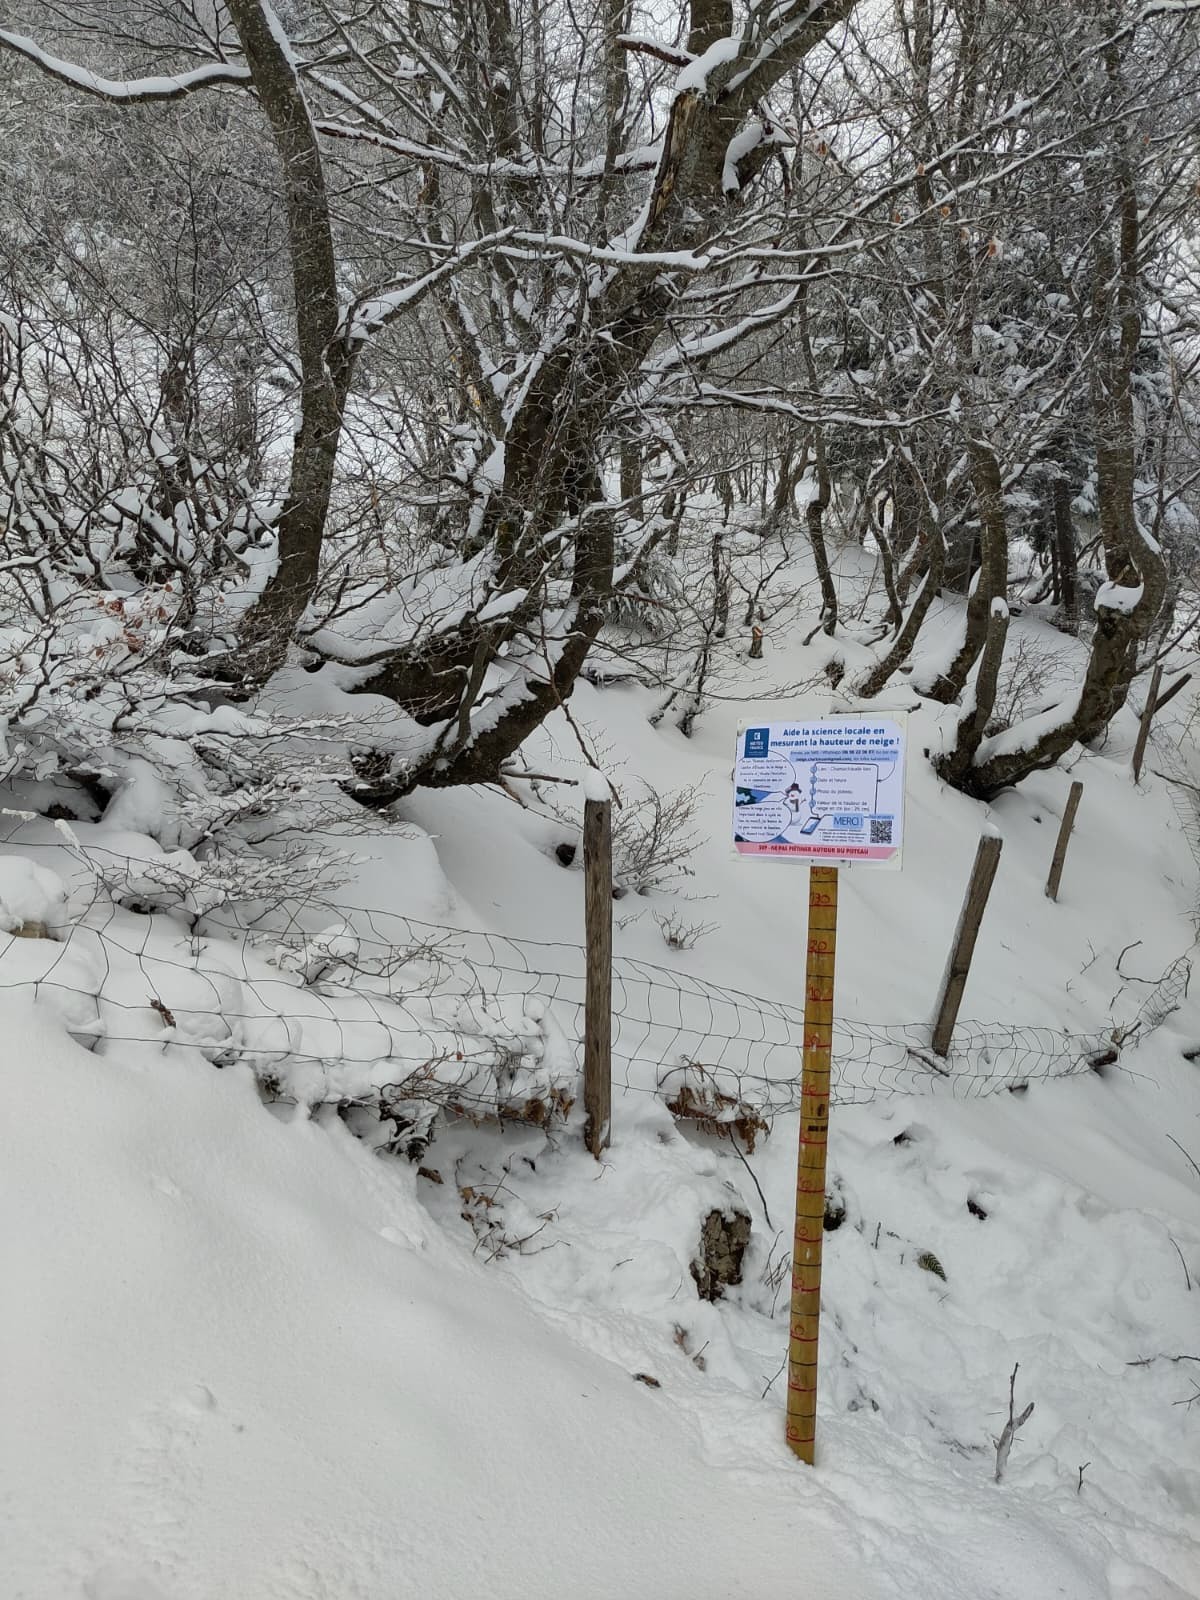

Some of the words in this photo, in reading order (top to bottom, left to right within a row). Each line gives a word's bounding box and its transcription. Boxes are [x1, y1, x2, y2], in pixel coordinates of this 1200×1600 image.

[783, 728, 800, 736] Aide
[844, 727, 871, 735] locale
[770, 739, 807, 747] mesurant
[810, 738, 817, 746] la
[819, 737, 853, 746] hauteur
[856, 737, 866, 745] de
[869, 737, 894, 747] neige
[833, 816, 859, 826] MERCI
[846, 847, 869, 855] POTEAU
